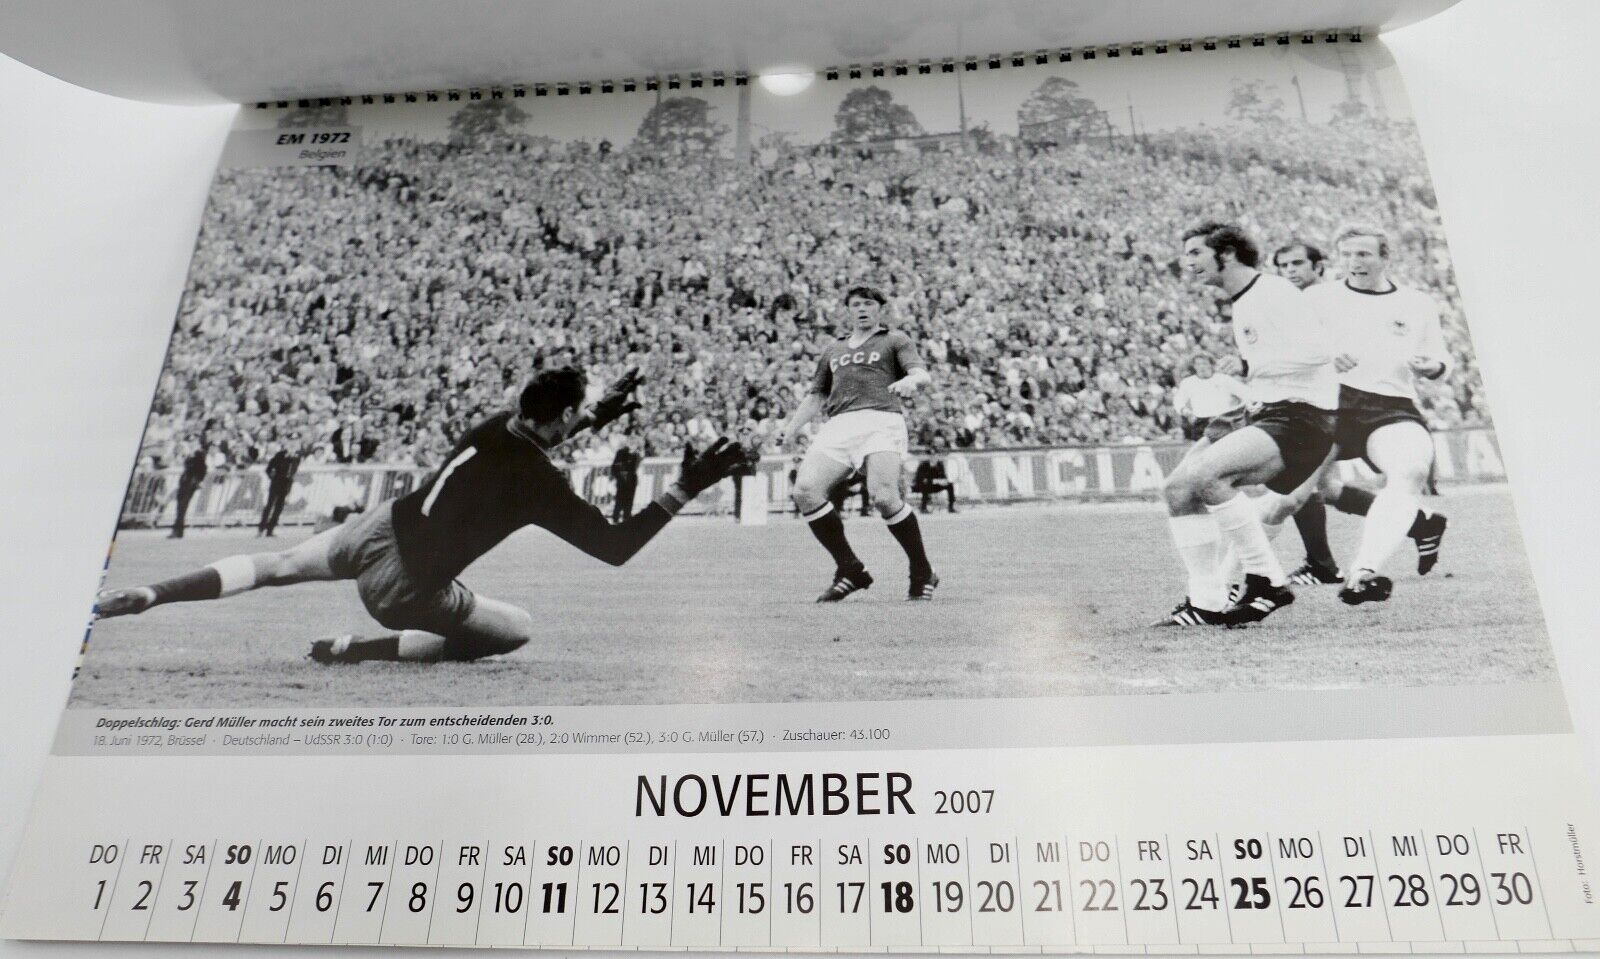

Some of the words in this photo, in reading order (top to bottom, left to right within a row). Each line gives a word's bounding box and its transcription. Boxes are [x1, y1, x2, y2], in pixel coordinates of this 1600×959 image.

[276, 133, 305, 145] EM
[310, 132, 351, 145] 1972
[299, 149, 346, 161] Belgien
[96, 716, 182, 731] Doppelschlag:
[184, 716, 215, 728] Gerd
[216, 716, 257, 728] Müller
[258, 716, 298, 727] macht
[299, 716, 326, 727] sein
[328, 716, 375, 727] zweites
[378, 716, 398, 727] Tor
[400, 717, 426, 727] zum
[429, 714, 528, 726] entscheidenden
[531, 715, 555, 726] 3:0.
[110, 735, 132, 746] Juni
[137, 735, 163, 748] 1972,
[167, 733, 207, 746] Brüssel
[222, 733, 291, 746] Deutschland
[304, 734, 341, 745] UdSSR
[343, 734, 363, 745] 3:0
[366, 733, 393, 747] (1:0)
[410, 733, 437, 745] Tore:
[442, 733, 459, 745] 1:0
[462, 733, 474, 744] G.
[477, 732, 513, 744] Müller
[515, 732, 546, 746] (28.),
[549, 732, 569, 744] 2:0
[572, 732, 622, 744] Wimmer
[624, 731, 654, 745] (52.),
[658, 731, 679, 743] 3:0
[682, 731, 695, 742] G.
[698, 730, 734, 742] Müller
[737, 730, 765, 744] (57.)
[782, 729, 846, 741] Zuschauer:
[849, 728, 890, 740] 43.100
[635, 771, 917, 818] NOVEMBER
[934, 789, 996, 815] 2007
[88, 844, 119, 865] DO
[139, 844, 164, 865] FR
[182, 844, 206, 865] SA
[224, 844, 253, 865] SO
[263, 844, 297, 866] MO
[321, 845, 344, 865] DI
[364, 845, 389, 866] MI
[404, 845, 434, 866] DO
[458, 845, 481, 866] FR
[502, 845, 527, 867] SA
[546, 845, 574, 867] SO
[587, 845, 621, 867] MO
[648, 845, 668, 866] DI
[692, 845, 716, 866] MI
[734, 844, 765, 866] DO
[791, 844, 814, 866] FR
[837, 844, 863, 866] SA
[883, 843, 912, 865] SO
[927, 843, 961, 865] MO
[989, 842, 1011, 864] DI
[1036, 841, 1060, 863] MI
[1079, 840, 1110, 862] DO
[1137, 840, 1163, 862] FR
[1186, 839, 1214, 861] SA
[1233, 838, 1263, 860] SO
[1277, 837, 1314, 859] MO
[1342, 836, 1367, 858] DI
[1391, 835, 1419, 857] MI
[1435, 833, 1470, 856] DO
[1496, 833, 1525, 855] FR
[93, 879, 108, 910] 1
[130, 879, 153, 911] 2
[176, 880, 199, 912] 3
[221, 880, 243, 912] 4
[268, 881, 289, 912] 5
[315, 880, 335, 913] 6
[365, 881, 385, 913] 7
[408, 881, 428, 913] 8
[455, 881, 475, 914] 9
[494, 881, 524, 914] 10
[541, 881, 568, 914] 11
[592, 882, 620, 914] 12
[639, 882, 668, 915] 13
[686, 882, 716, 915] 14
[736, 882, 766, 915] 15
[783, 881, 815, 915] 16
[836, 881, 866, 914] 17
[880, 880, 915, 914] 18
[932, 880, 964, 913] 19
[976, 880, 1015, 913] 20
[1033, 879, 1063, 912] 21
[1079, 878, 1119, 912] 22
[1130, 878, 1169, 912] 23
[1181, 877, 1220, 911] 24
[1229, 876, 1272, 910] 25
[1283, 875, 1325, 909] 26
[1339, 874, 1375, 908] 27
[1387, 873, 1430, 908] 28
[1439, 872, 1482, 907] 29
[1489, 871, 1534, 906] 30
